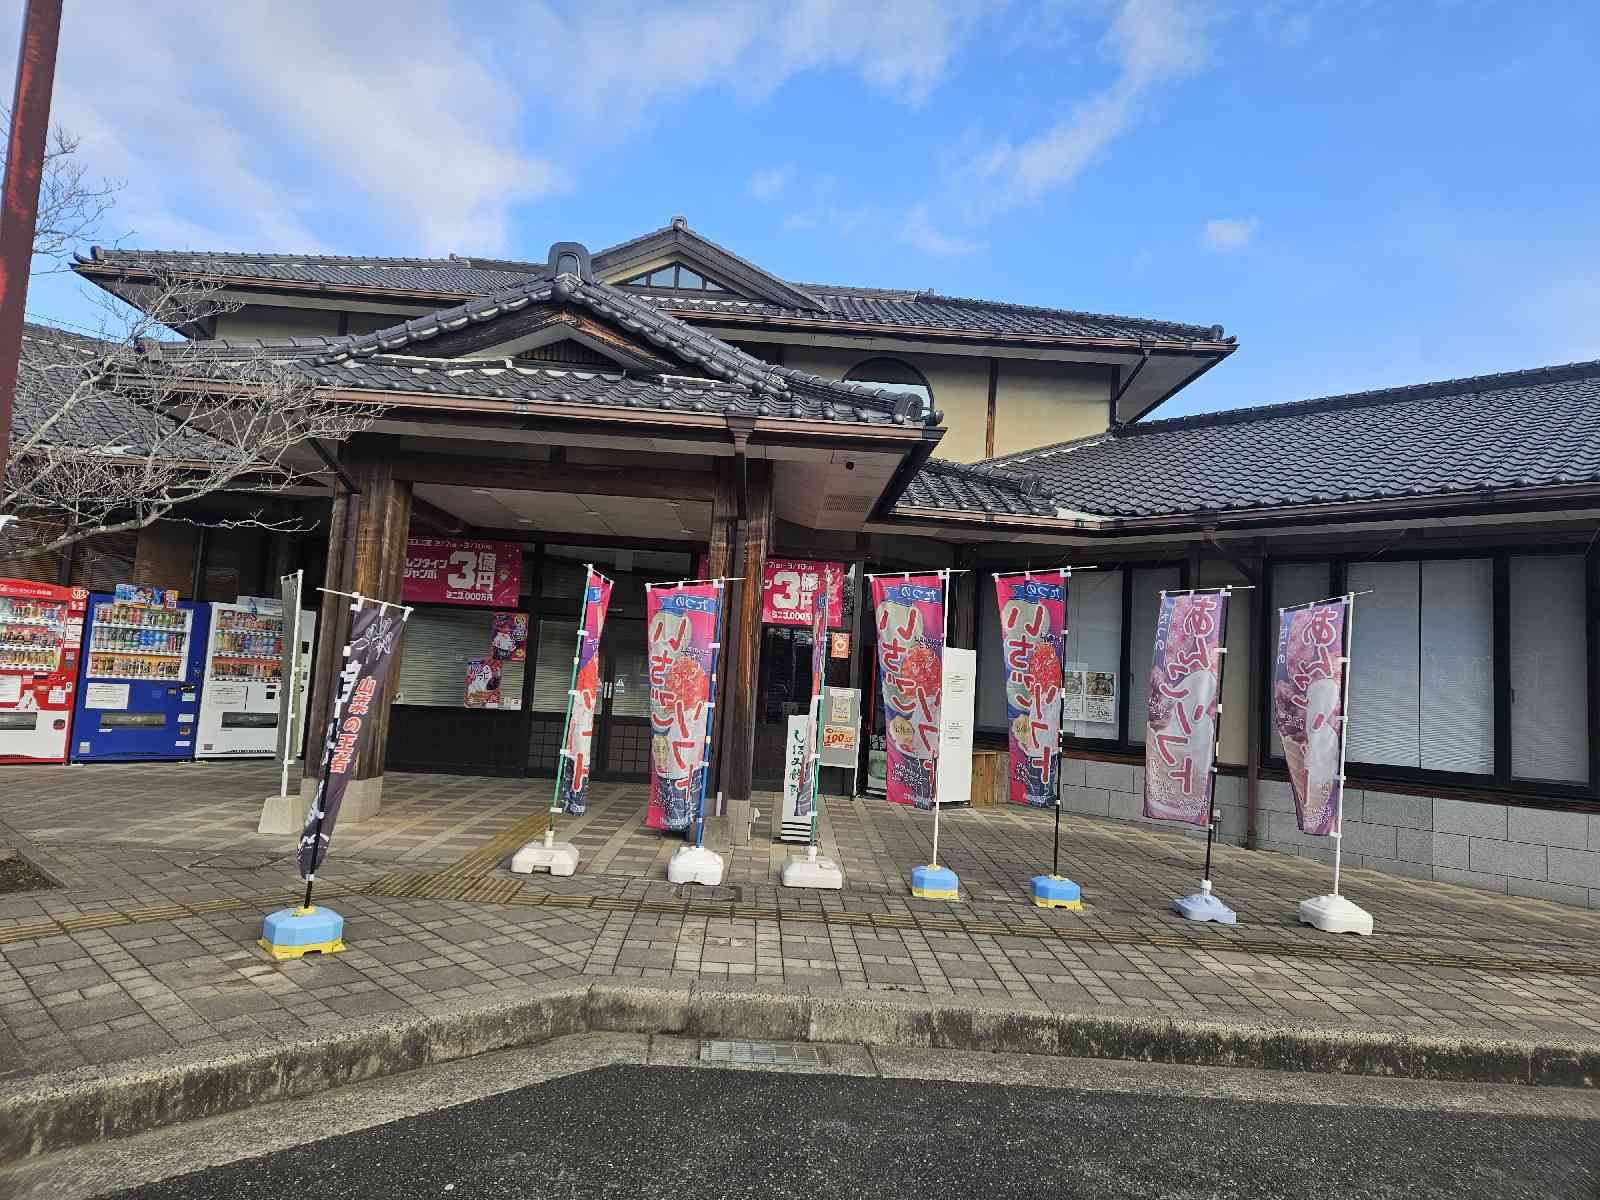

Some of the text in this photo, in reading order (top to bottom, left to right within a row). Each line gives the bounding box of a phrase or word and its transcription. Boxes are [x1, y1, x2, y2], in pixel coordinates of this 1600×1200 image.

[406, 557, 448, 569] レンタイン
